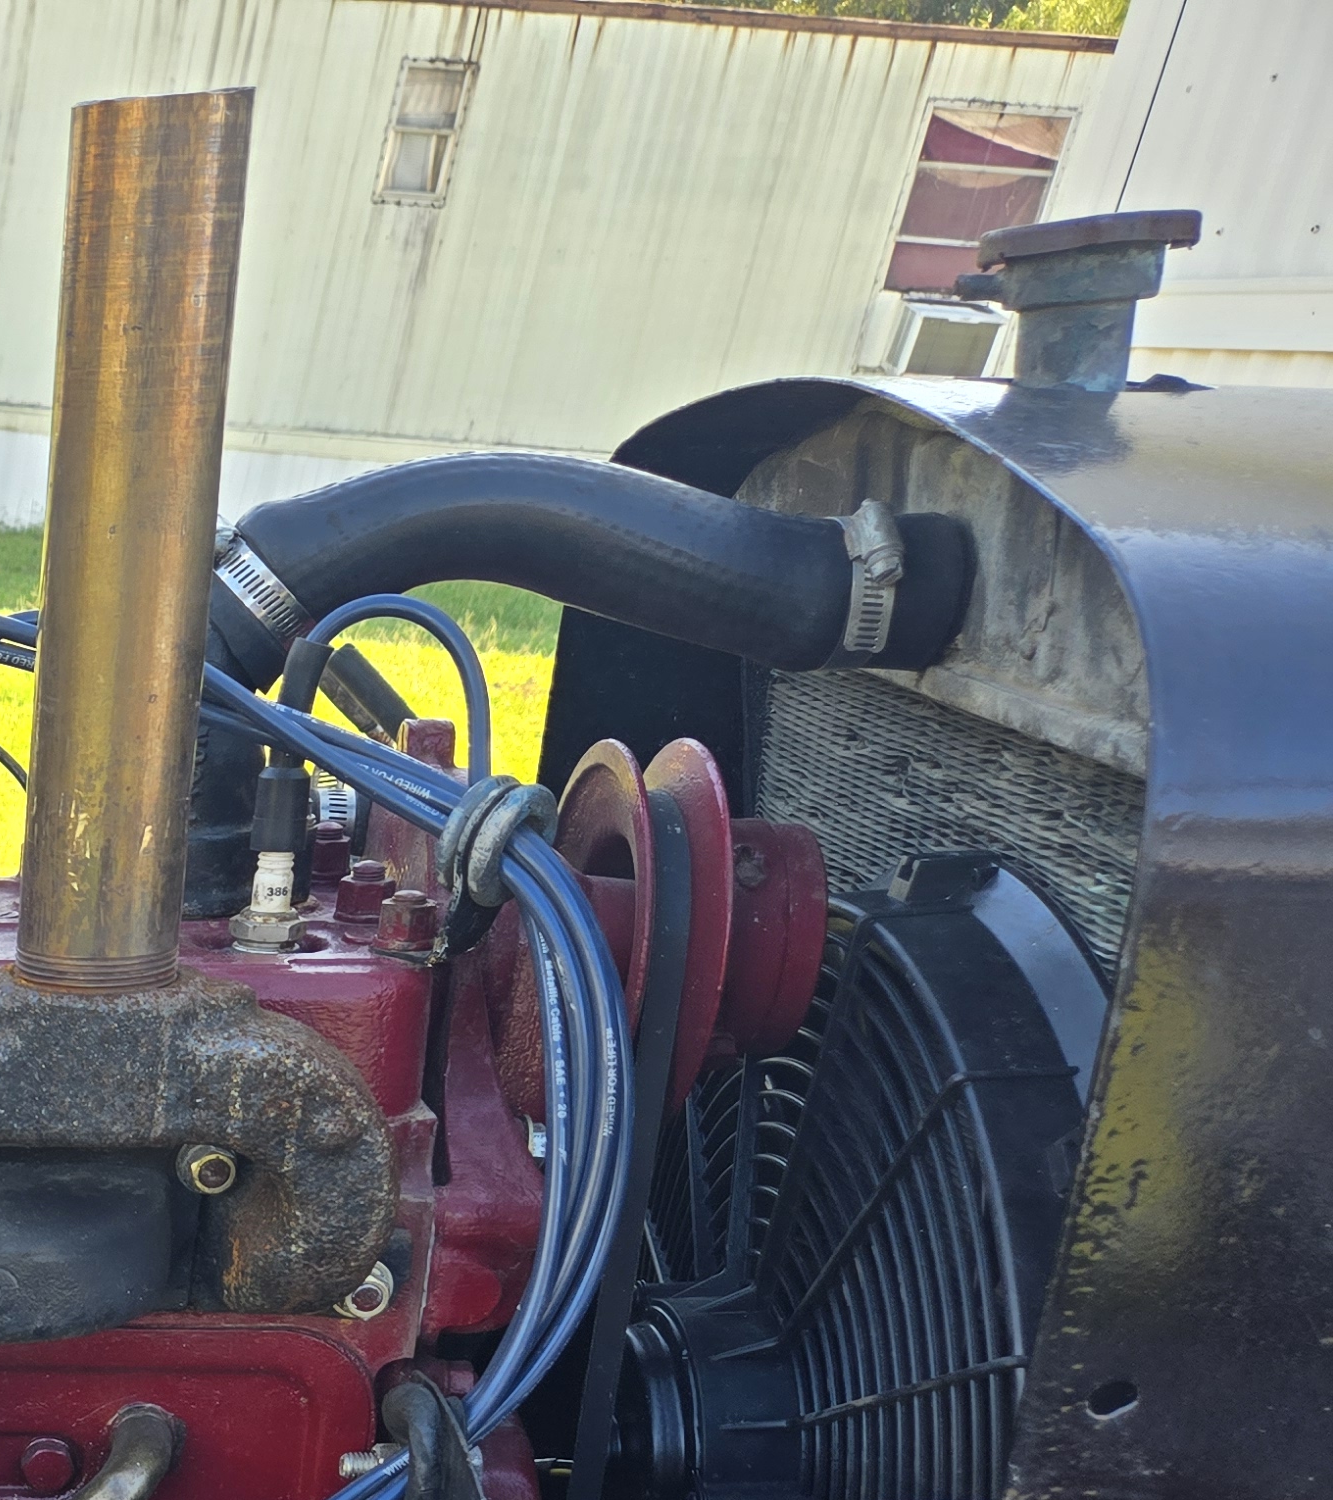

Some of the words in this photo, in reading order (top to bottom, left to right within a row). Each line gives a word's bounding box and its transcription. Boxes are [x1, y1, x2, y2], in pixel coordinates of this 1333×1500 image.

[11, 656, 35, 668] RED
[266, 886, 289, 899] 386
[550, 1008, 562, 1042] Cable
[555, 1059, 566, 1086] SAE
[606, 1068, 618, 1093] FOR
[557, 1103, 567, 1118] 20
